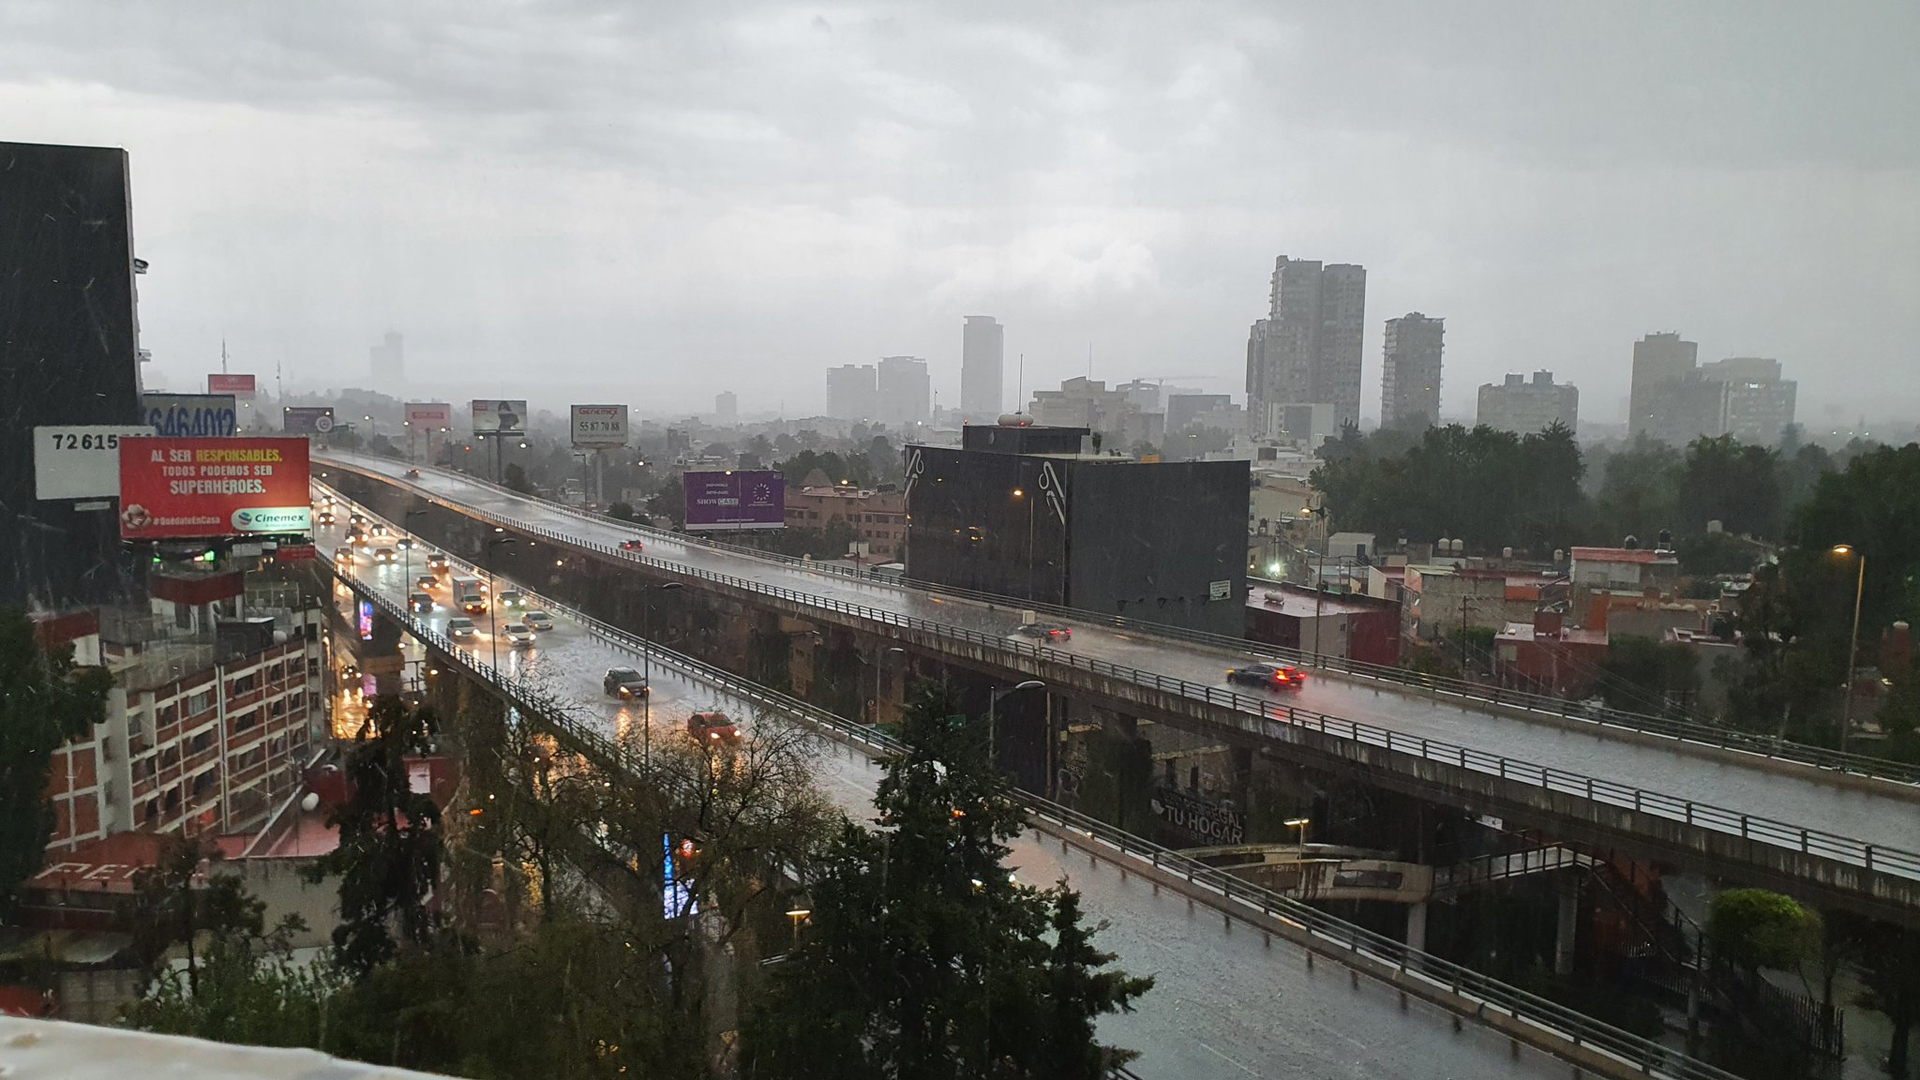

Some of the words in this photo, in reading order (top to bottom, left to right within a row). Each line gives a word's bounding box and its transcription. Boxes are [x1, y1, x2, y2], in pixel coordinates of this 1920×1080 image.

[52, 434, 151, 450] 72615
[151, 450, 165, 462] AL
[170, 449, 191, 462] SER
[162, 465, 195, 477] TODOS
[200, 465, 249, 477] PODEMOS
[254, 464, 272, 476] SER
[170, 477, 266, 495] SUPERHÉROES.
[255, 514, 304, 523] Cinemex
[1165, 804, 1184, 825] TU
[1189, 812, 1242, 845] HOGAR
